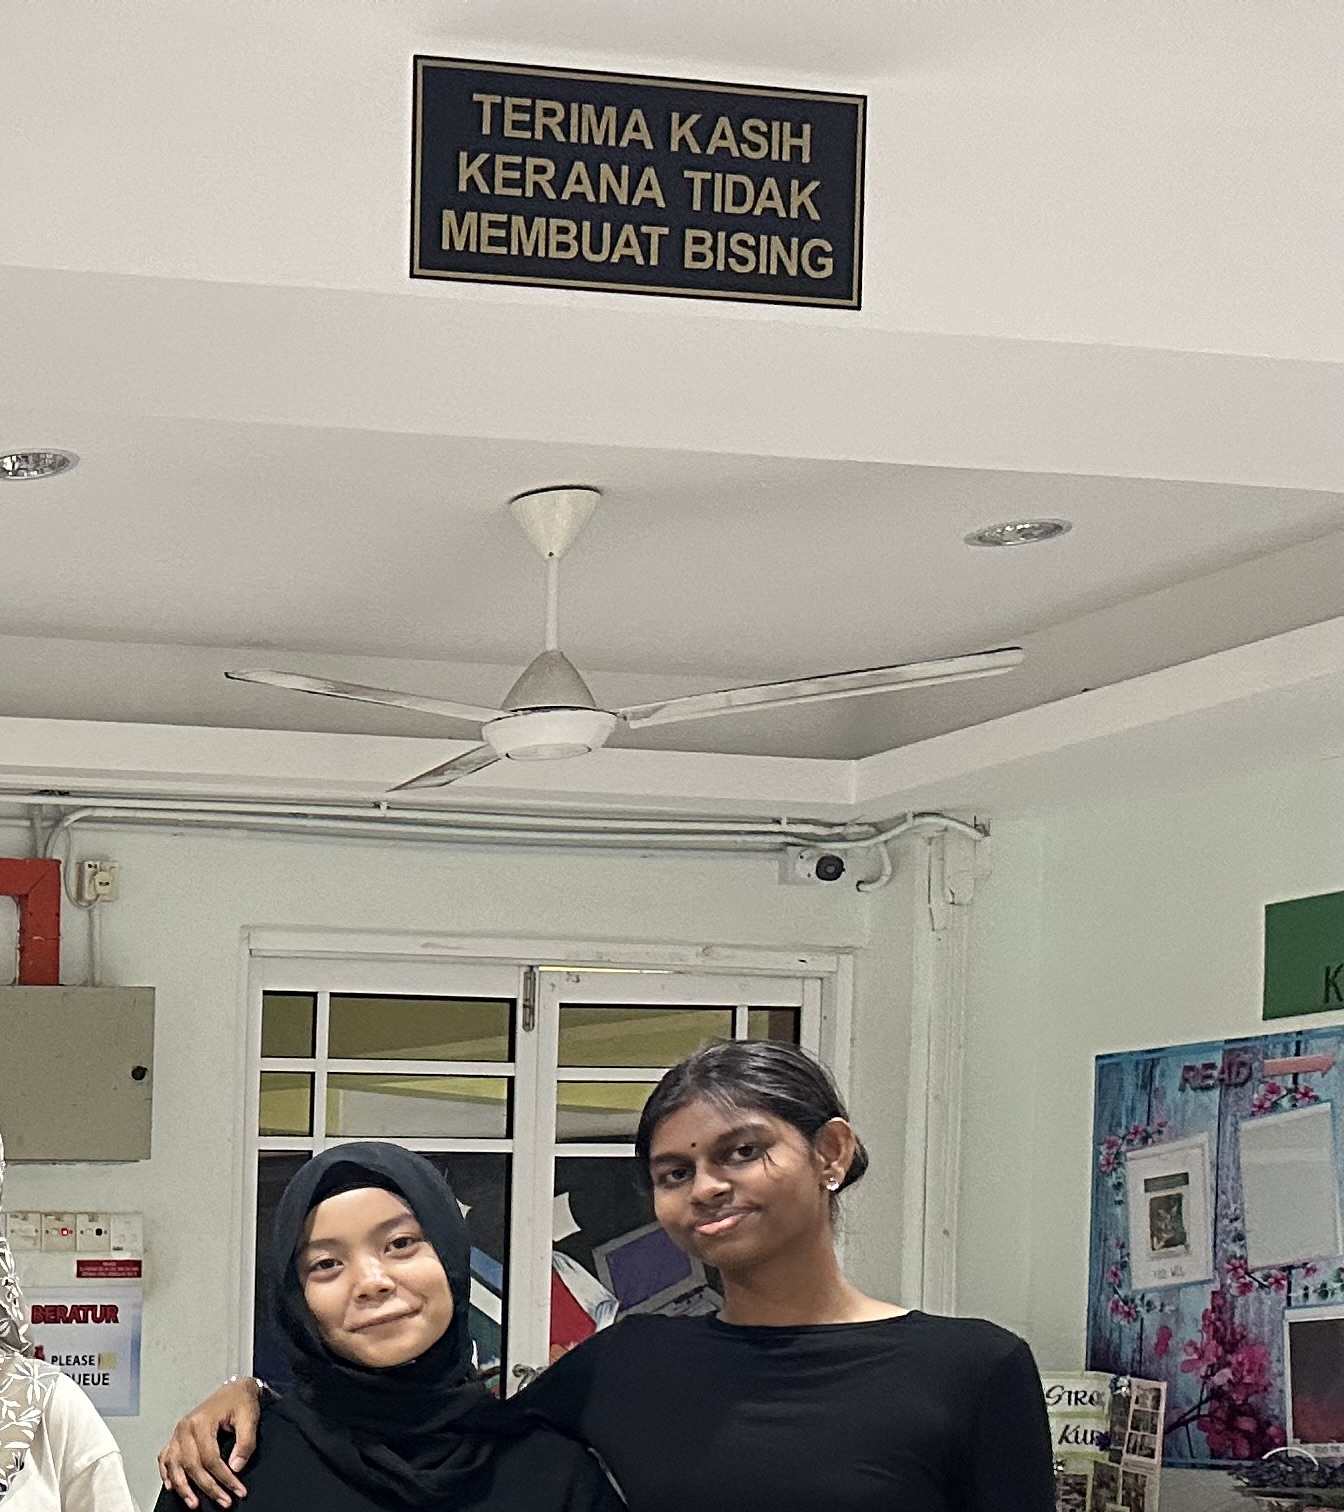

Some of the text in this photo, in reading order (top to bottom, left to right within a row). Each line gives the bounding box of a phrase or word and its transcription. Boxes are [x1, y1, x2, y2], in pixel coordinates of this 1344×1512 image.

[472, 93, 811, 163] TERIMA KASIH
[458, 152, 821, 221] KERANA TIDAK
[442, 209, 834, 279] MEMBUAT BISING
[1178, 1060, 1253, 1092] READ
[31, 1305, 119, 1324] BERATUR
[51, 1354, 96, 1366] PLEASE
